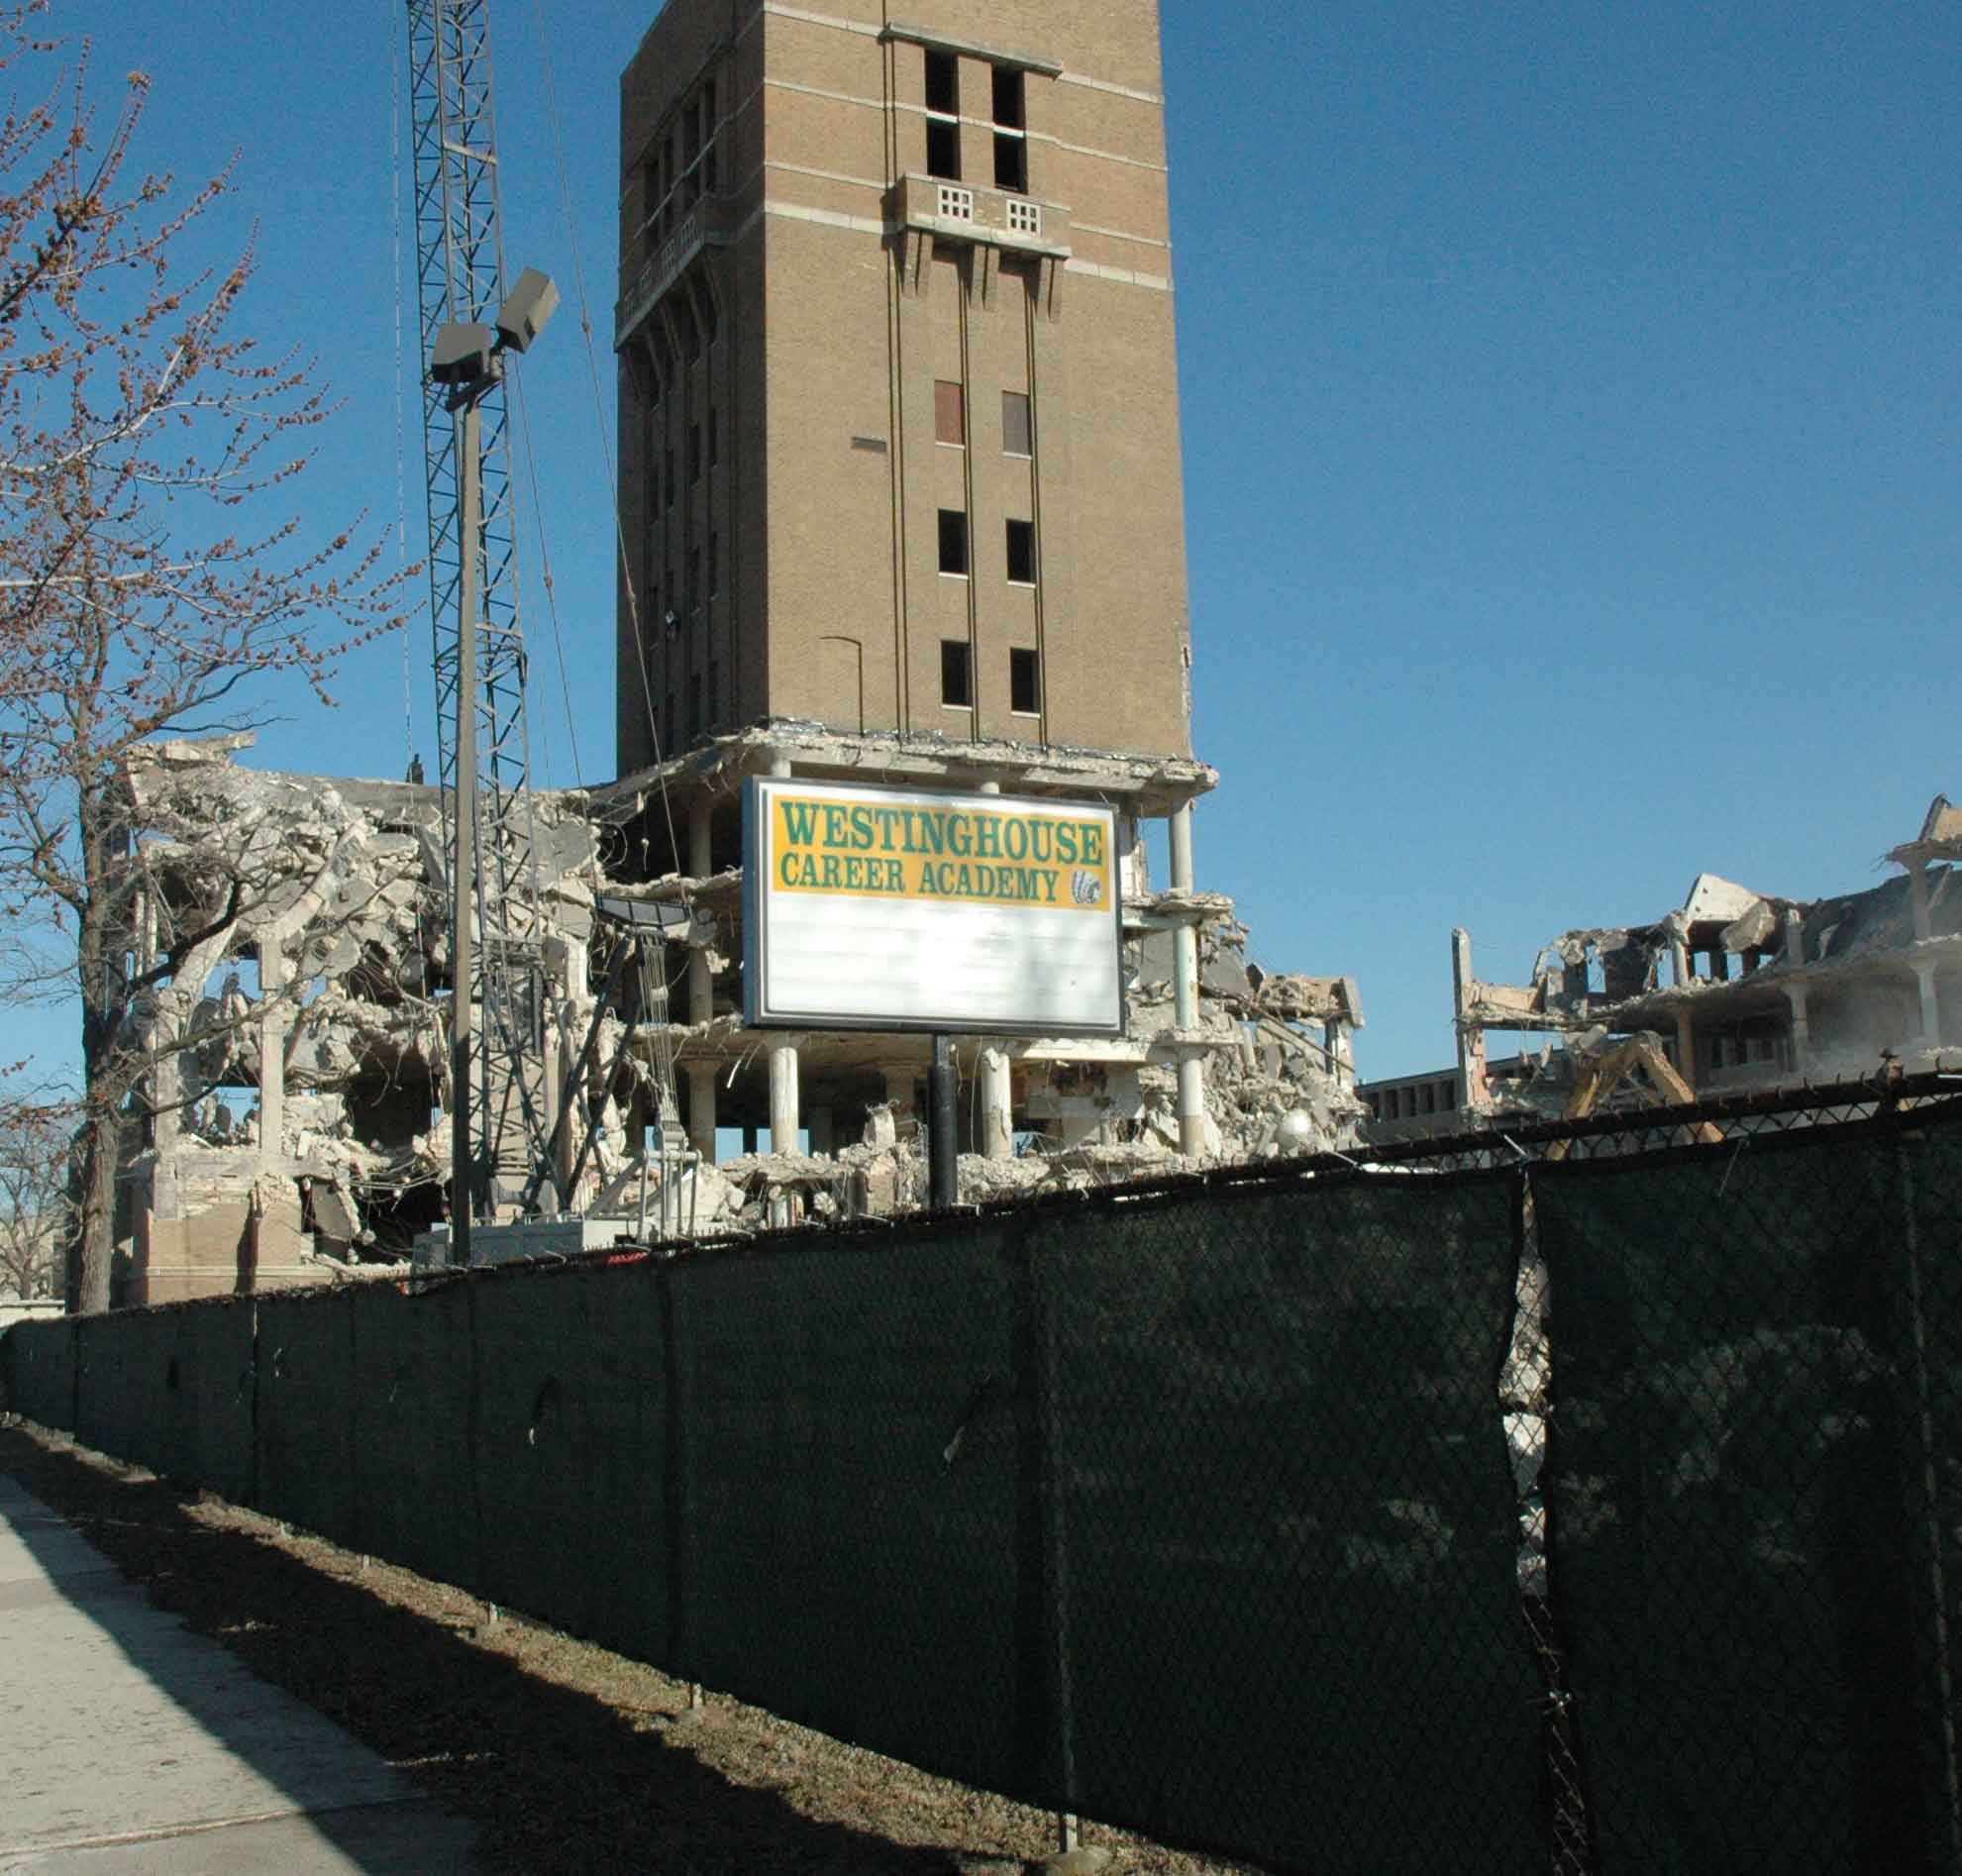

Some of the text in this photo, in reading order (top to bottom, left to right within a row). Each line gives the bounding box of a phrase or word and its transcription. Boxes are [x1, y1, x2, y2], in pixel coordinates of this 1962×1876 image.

[780, 801, 1102, 866] WESTINGHOUSE
[780, 852, 1060, 901] CAREER ACADEMY
